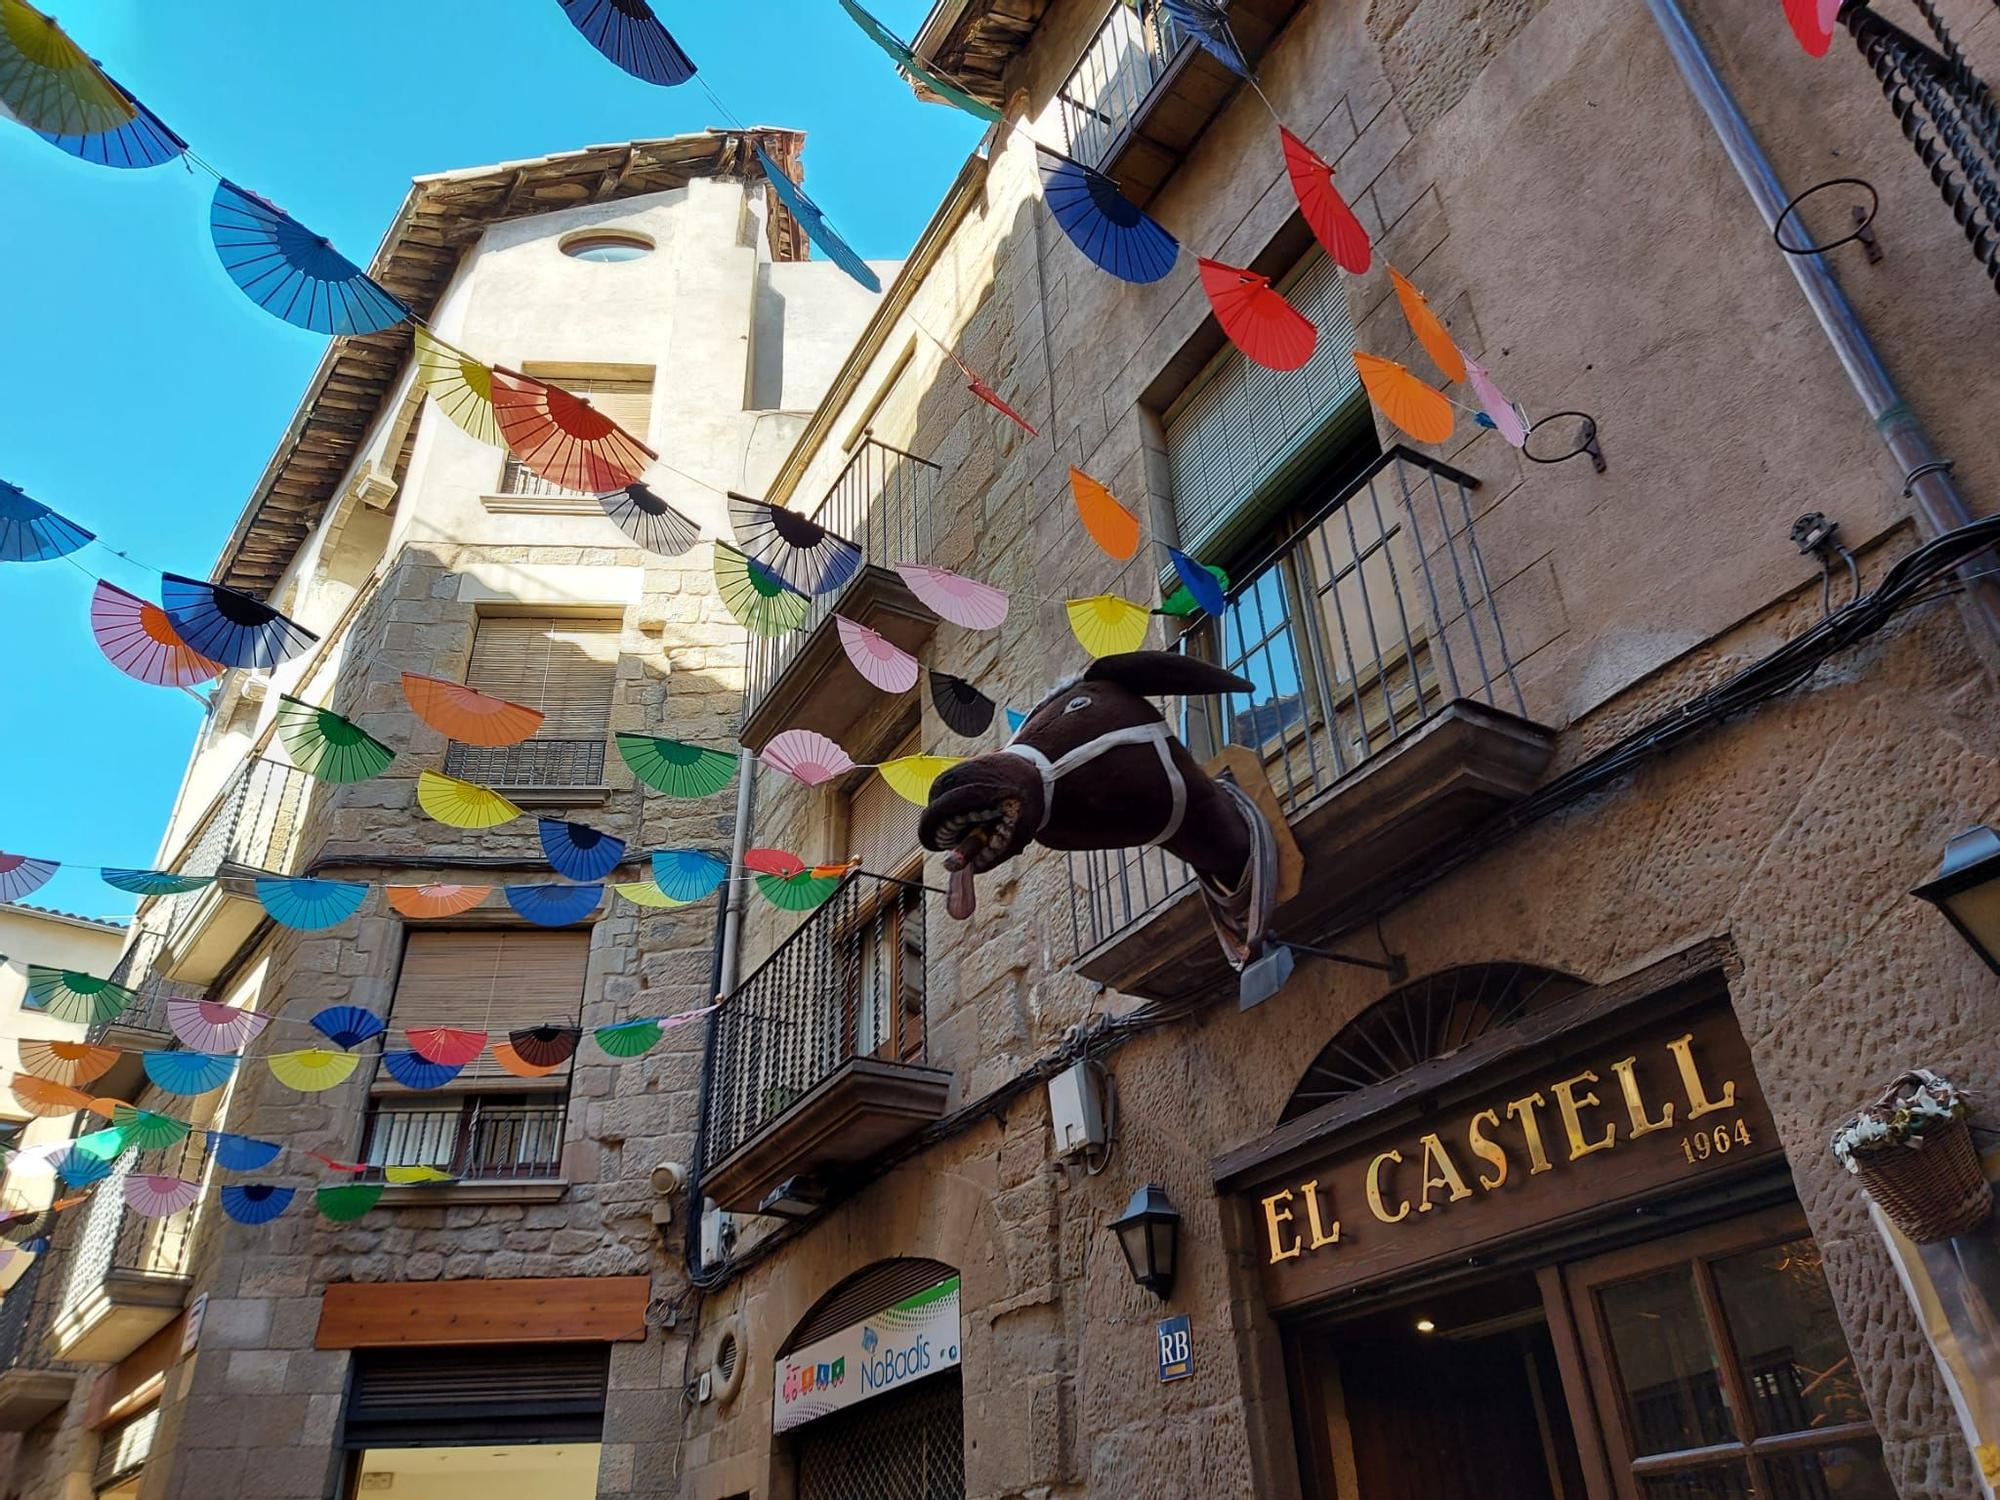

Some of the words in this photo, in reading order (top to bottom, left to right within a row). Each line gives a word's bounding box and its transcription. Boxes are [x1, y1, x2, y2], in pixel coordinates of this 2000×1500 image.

[1262, 1180, 1340, 1264] EL
[1366, 1033, 1736, 1223] CASTELL
[1680, 1119, 1752, 1164] 1964
[861, 1334, 930, 1394] NoBadis
[1160, 1331, 1189, 1365] RB
